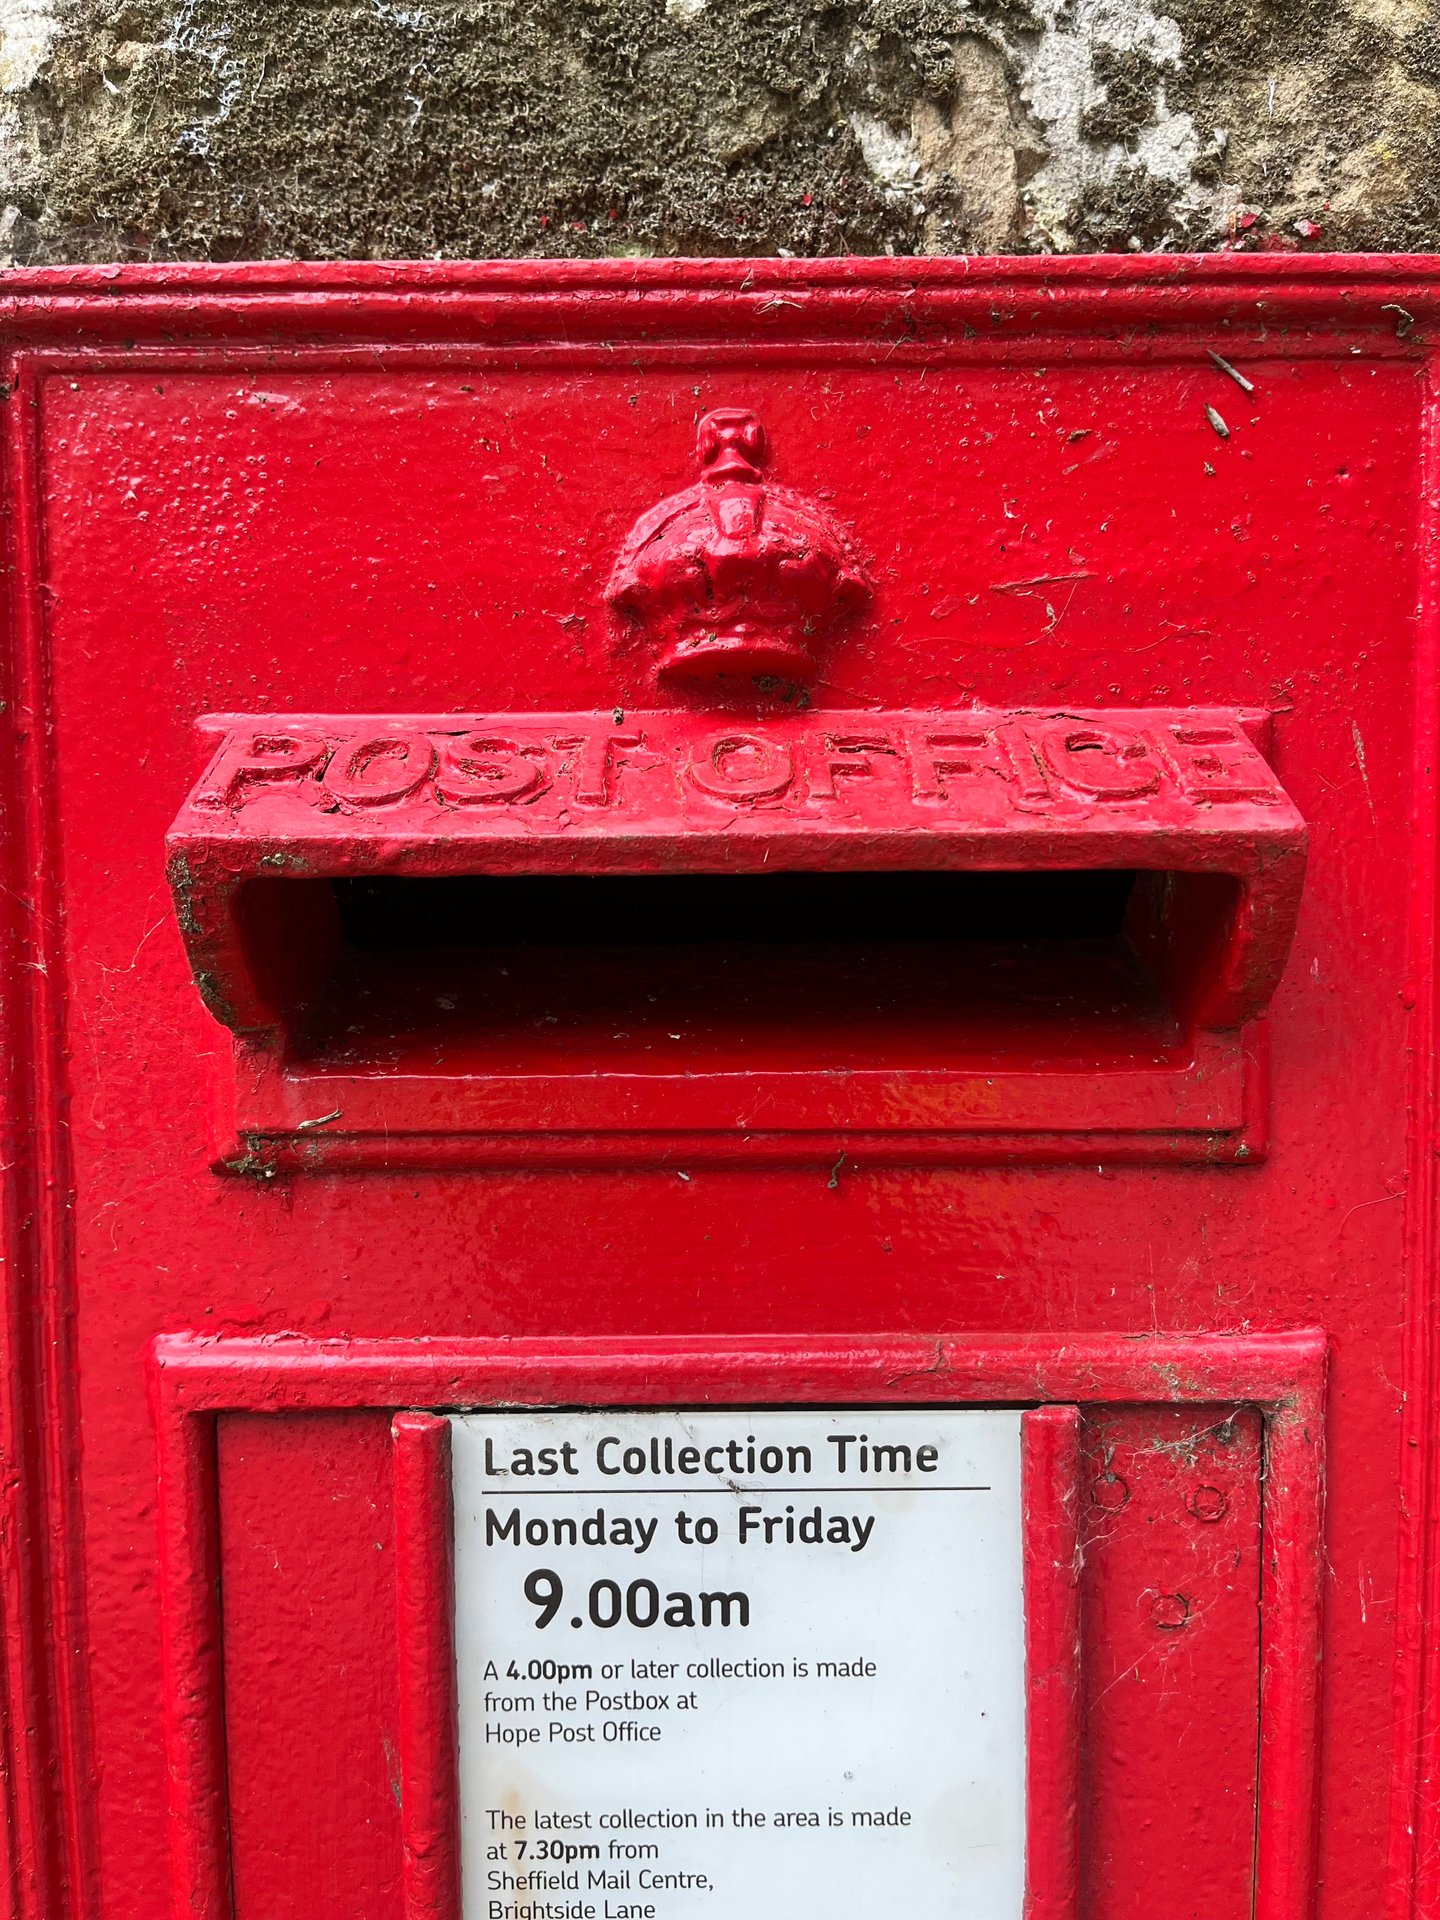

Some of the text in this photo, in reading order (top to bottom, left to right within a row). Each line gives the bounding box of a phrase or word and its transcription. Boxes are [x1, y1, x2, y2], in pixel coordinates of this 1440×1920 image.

[192, 724, 1285, 812] POST OFFICE
[485, 1434, 939, 1476] Last Collection Time
[485, 1505, 875, 1554] Monday to Friday
[523, 1568, 750, 1630] 9.00am
[483, 1656, 877, 1685] A 4.00pm or later collection is made
[484, 1689, 698, 1712] from the Postbox at
[485, 1720, 661, 1748] Hope Post Office
[485, 1806, 912, 1830] The latest collection in the area is made
[486, 1839, 659, 1865] at 7.30pm from
[487, 1869, 714, 1892] Sheffield Mail Centre,
[488, 1899, 656, 1920] Brightside Lane
